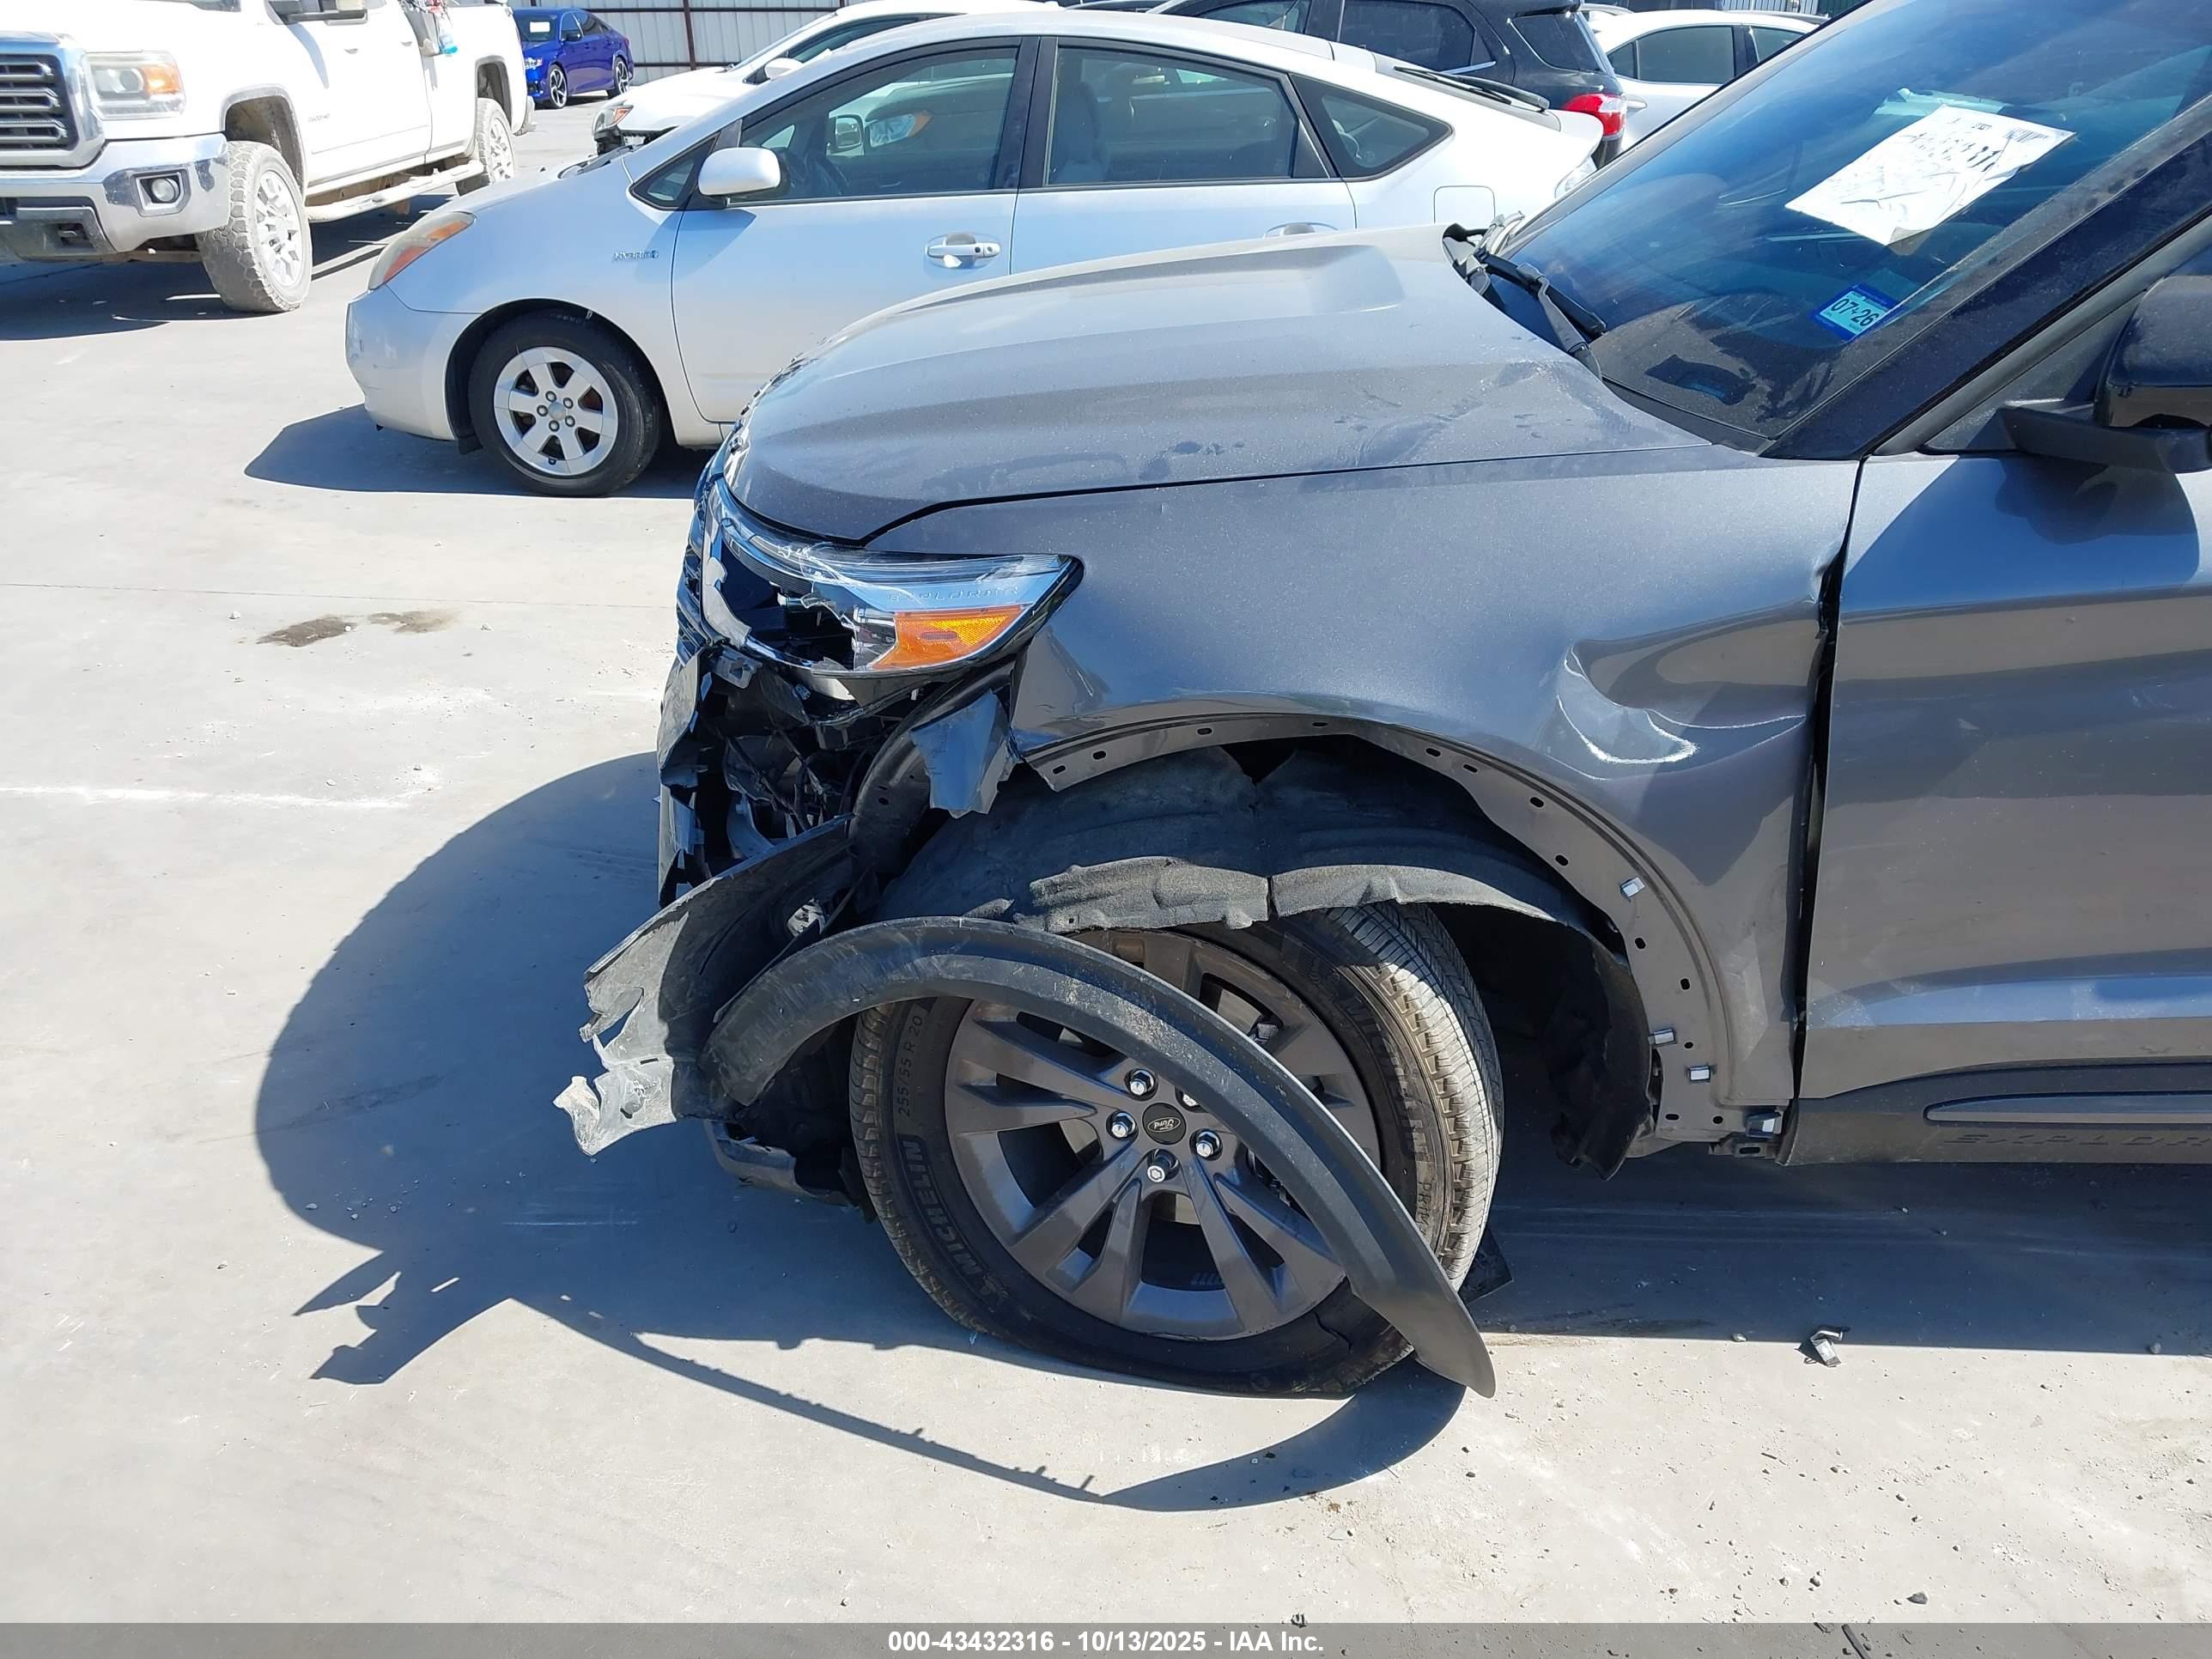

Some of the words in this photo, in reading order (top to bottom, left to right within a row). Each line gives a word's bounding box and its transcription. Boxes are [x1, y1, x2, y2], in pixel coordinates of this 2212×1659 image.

[897, 1057, 914, 1115] 255/55
[908, 1014, 923, 1036] 20
[1153, 1118, 1174, 1130] Ford
[901, 1139, 982, 1276] MICHELIN
